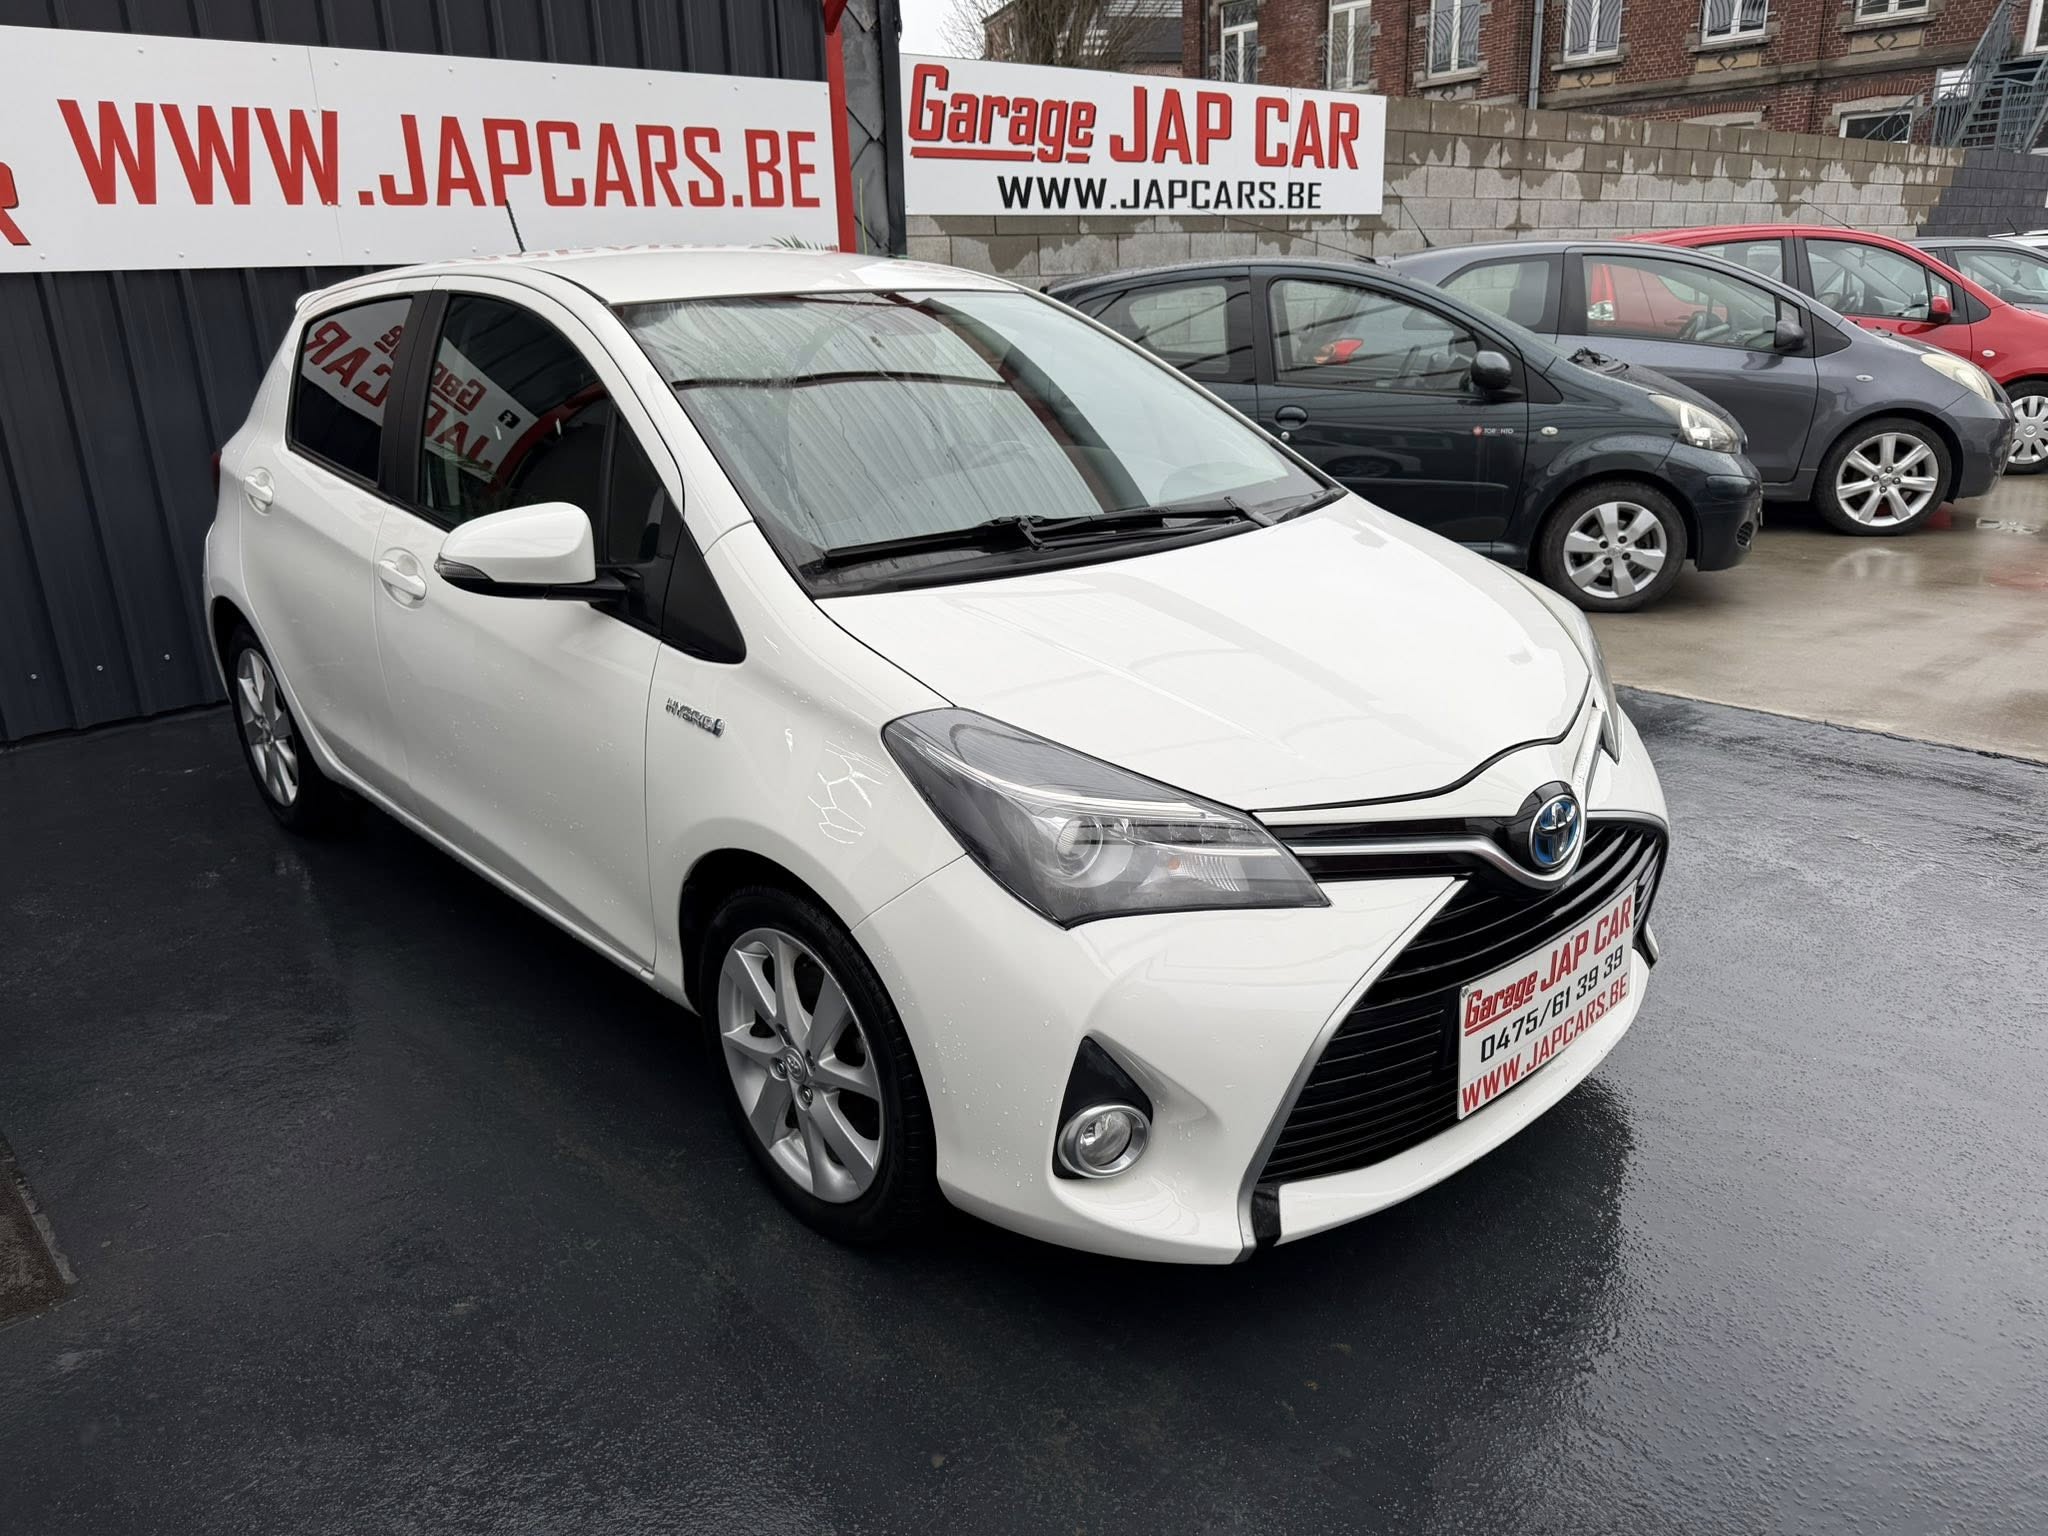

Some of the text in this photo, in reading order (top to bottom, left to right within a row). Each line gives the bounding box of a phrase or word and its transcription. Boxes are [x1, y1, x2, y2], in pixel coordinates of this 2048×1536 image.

[57, 99, 822, 209] WWW.JAPCARS.BE
[908, 63, 1360, 170] Garage JAP CAR
[997, 175, 1323, 210] WWW.JAPCARS.BE
[1484, 427, 1514, 435] TORNTO
[1464, 894, 1632, 1031] Garage JAP CAR
[1480, 944, 1624, 1063] 0475/61 39 39
[1461, 972, 1629, 1114] WWW.JAPCARS.BE
